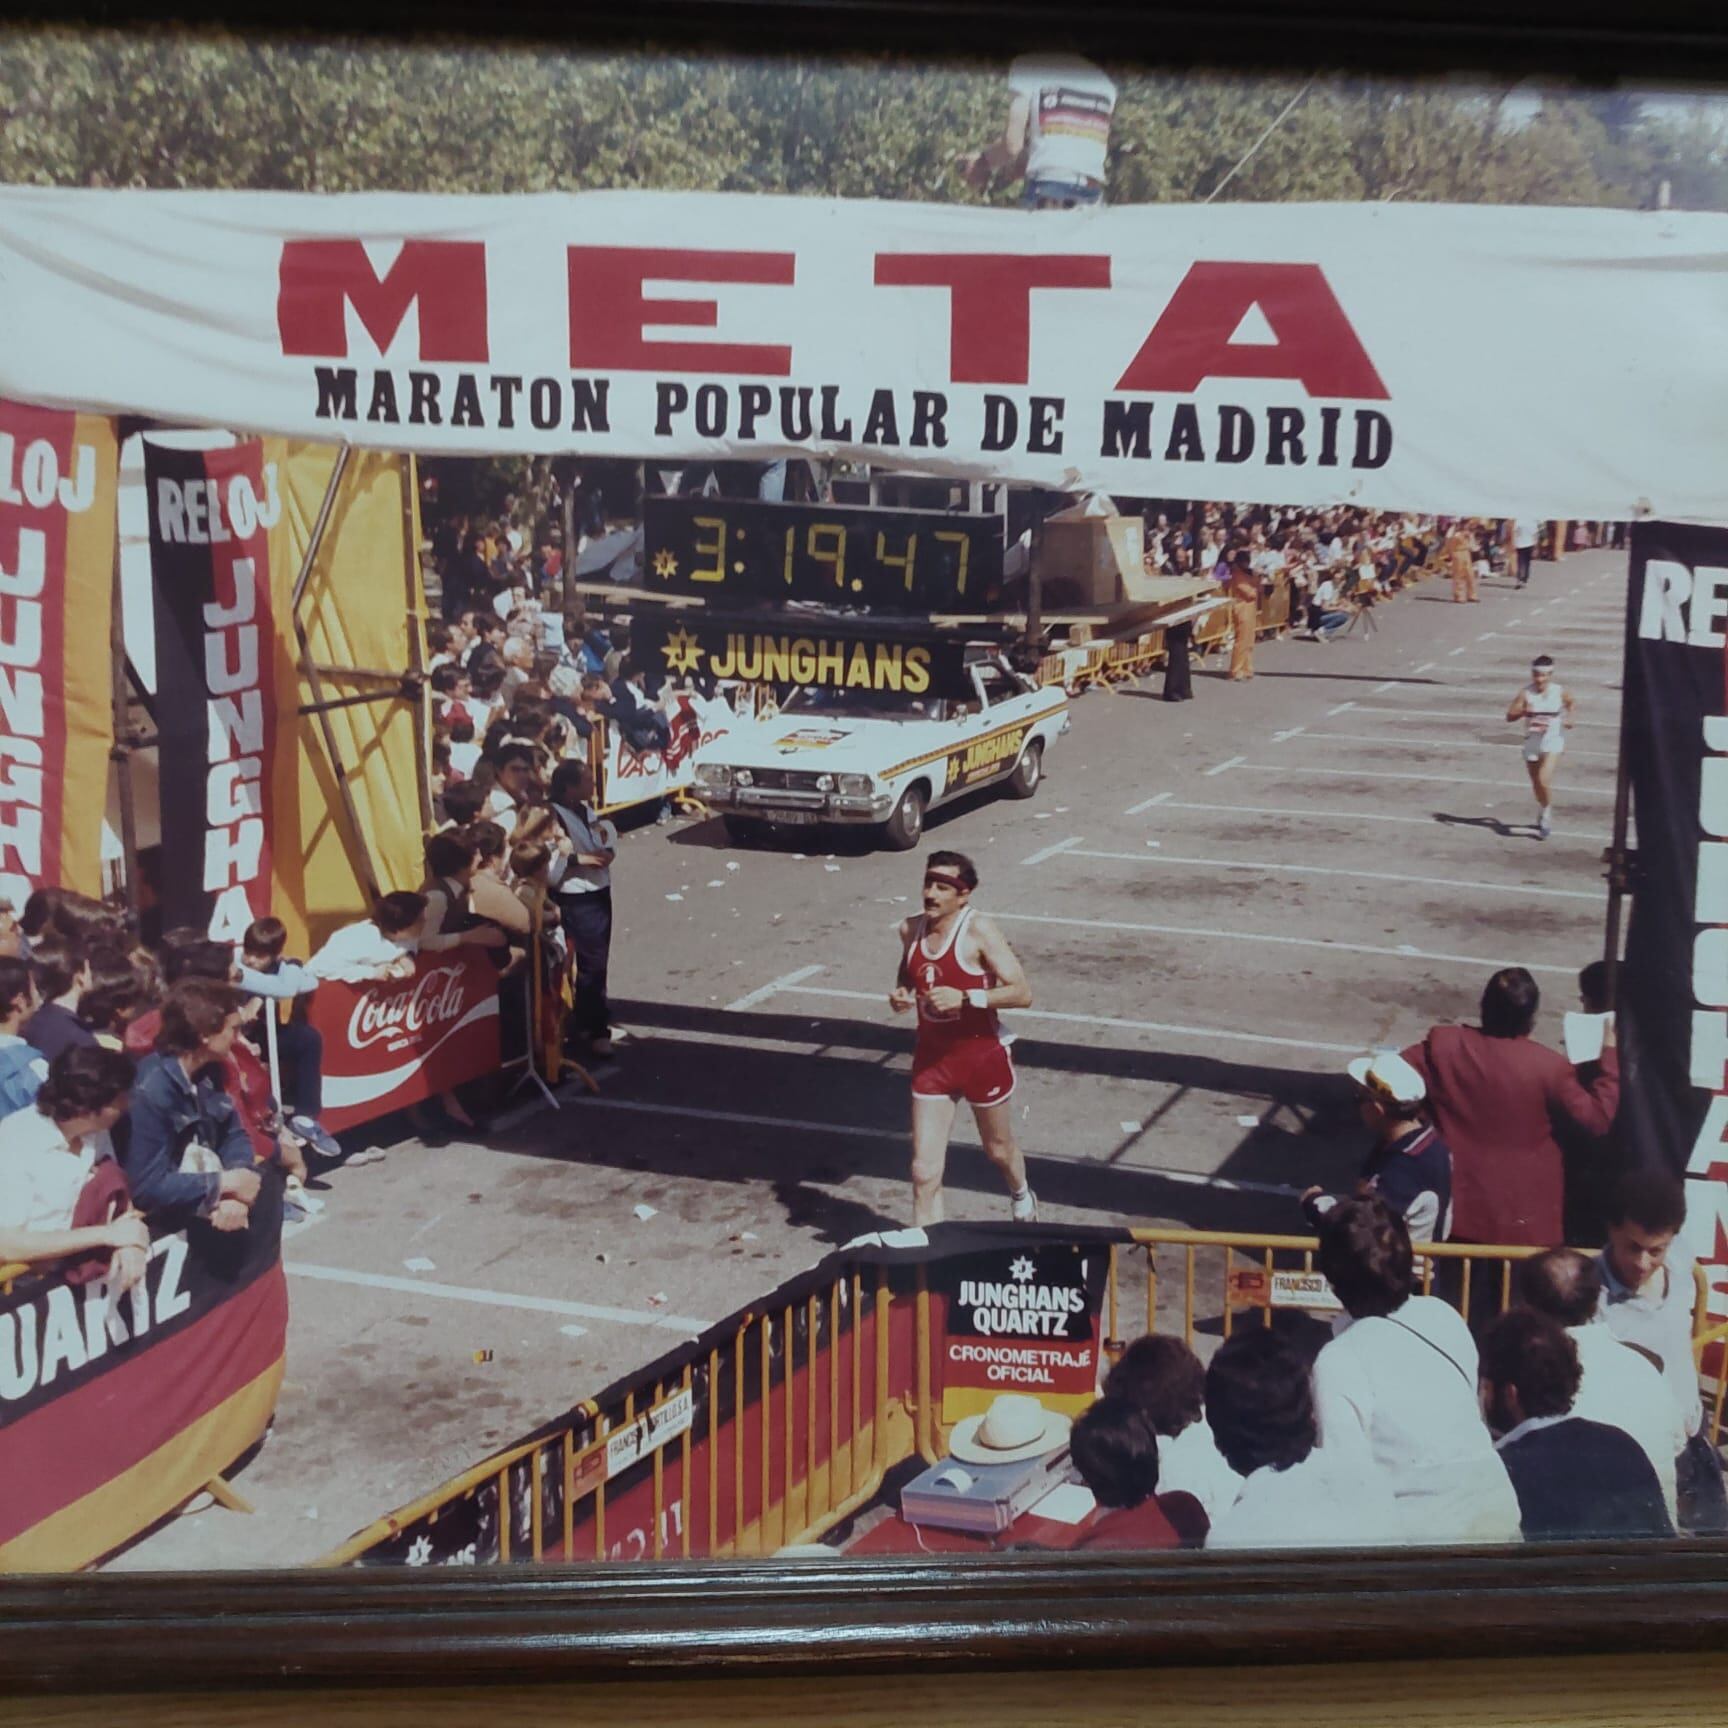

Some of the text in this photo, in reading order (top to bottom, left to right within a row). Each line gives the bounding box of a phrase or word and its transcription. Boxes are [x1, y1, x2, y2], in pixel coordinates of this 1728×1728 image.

[278, 238, 1392, 400] META
[314, 366, 1393, 469] MARATON POPULAR DE MADRID
[157, 462, 281, 543] RELOJ
[710, 633, 931, 694] JUNGHANS
[962, 728, 1024, 774] JUNGHANS
[958, 1280, 1085, 1313] JUNGHANS
[973, 1307, 1069, 1337] QUARTZ
[949, 1344, 1092, 1368] CRONOMETRAJE
[986, 1366, 1055, 1384] OFICIAL
[609, 1423, 647, 1457] FRANCIS
